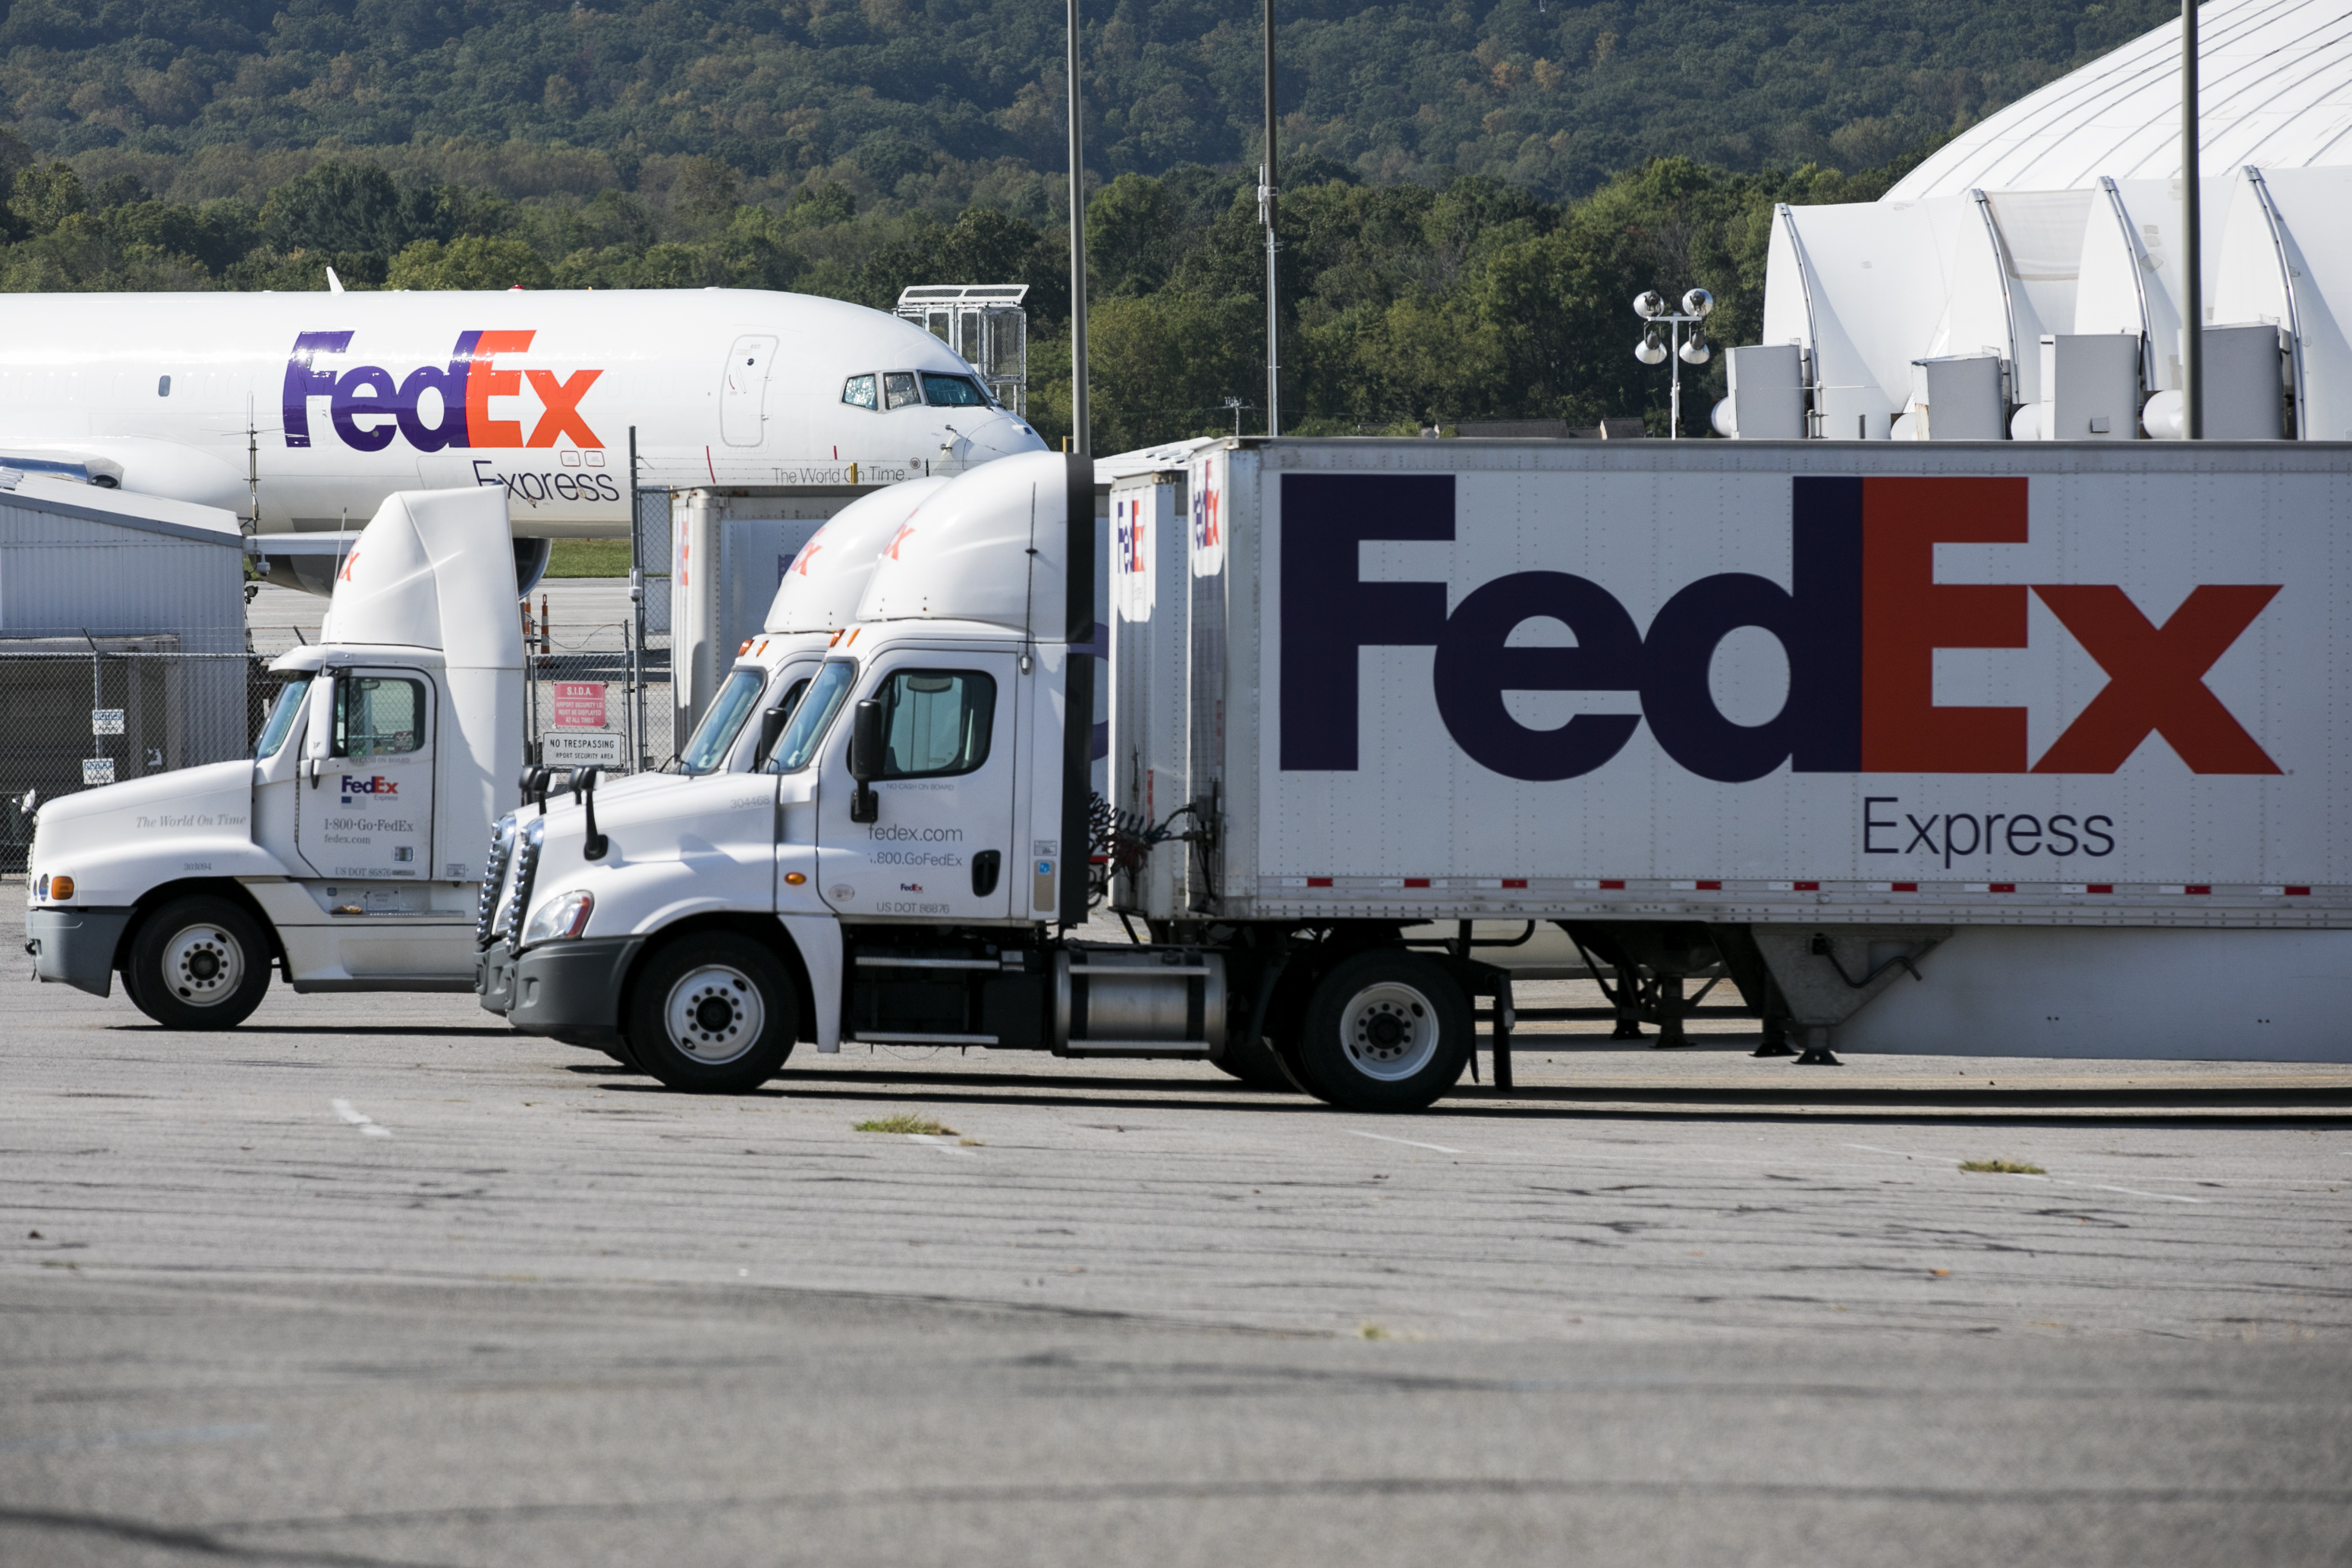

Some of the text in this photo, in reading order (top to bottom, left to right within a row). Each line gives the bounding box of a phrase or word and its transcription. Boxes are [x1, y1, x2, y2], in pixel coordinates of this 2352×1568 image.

[283, 329, 606, 452] FedEx
[772, 467, 797, 484] The
[800, 467, 840, 483] World
[869, 466, 904, 482] Time
[473, 460, 620, 508] Express
[1280, 473, 2286, 784] FedEx
[567, 687, 593, 696] S.I.D.A.
[564, 740, 615, 749] TRESPASSING
[341, 775, 399, 794] FedEx
[730, 795, 770, 809] 304468
[137, 814, 247, 828] The World On Time
[324, 834, 370, 844] fedex.com
[867, 823, 963, 842] fedex.com
[1862, 796, 2115, 869] Express
[335, 867, 347, 875] US
[348, 867, 366, 876] DOT
[900, 883, 923, 891] FedEx
[876, 901, 892, 913] US
[895, 902, 917, 913] DOT
